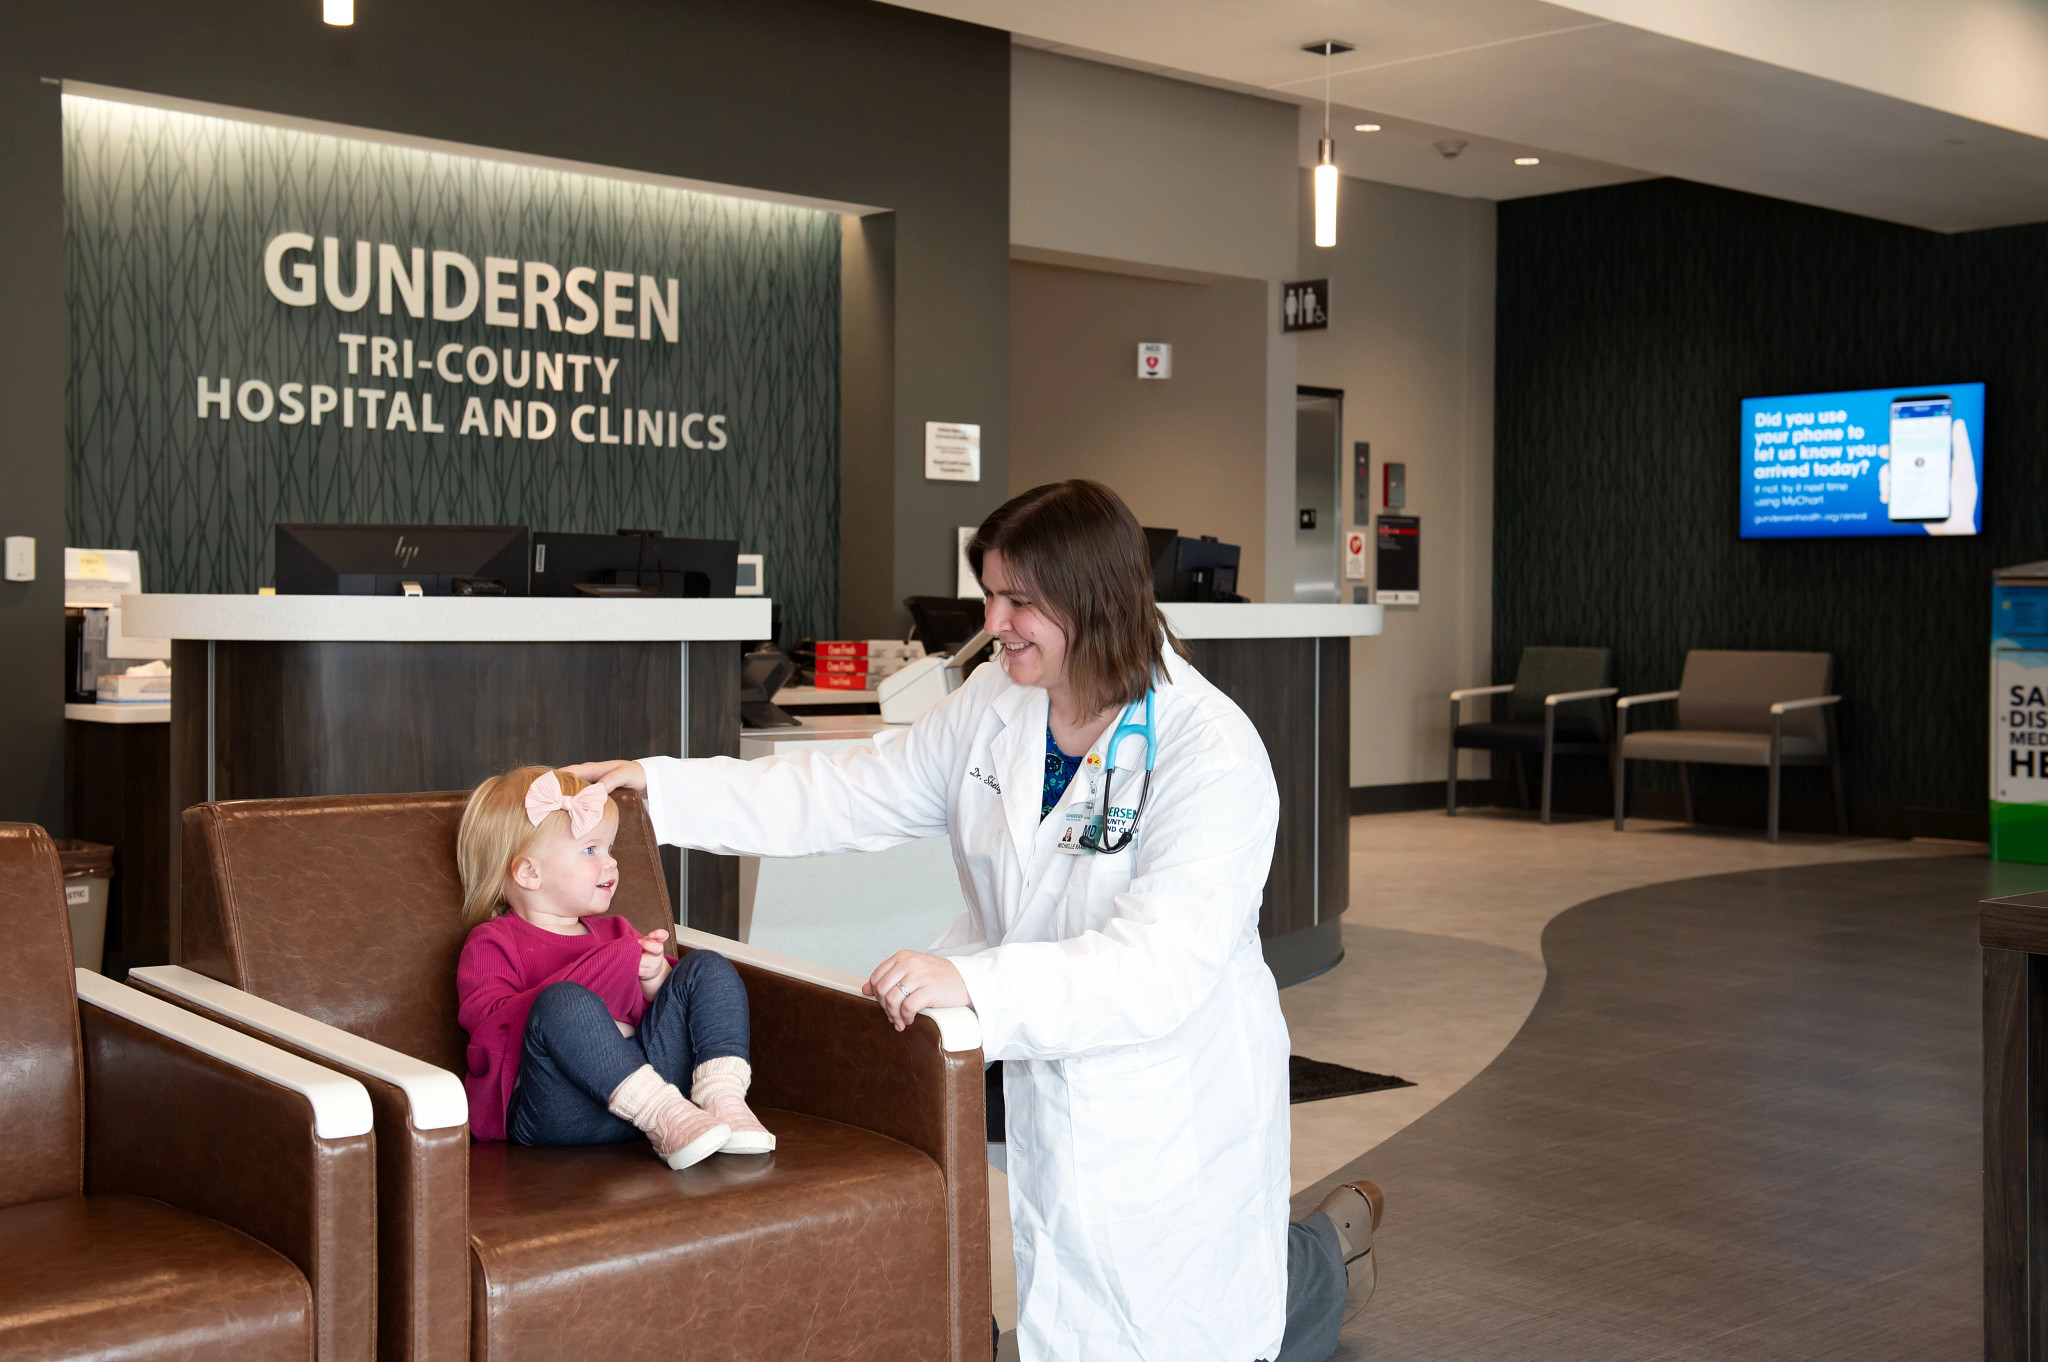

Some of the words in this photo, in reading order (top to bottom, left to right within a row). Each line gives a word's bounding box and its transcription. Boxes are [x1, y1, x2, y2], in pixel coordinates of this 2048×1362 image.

[264, 232, 679, 343] GUNDERSEN
[338, 333, 619, 395] TRI-COUNTY
[197, 376, 444, 433] HOSPITAL
[459, 397, 557, 440] AND
[570, 404, 728, 451] CLINICS
[1755, 411, 1782, 428] Did
[1785, 412, 1815, 429] you
[1818, 410, 1847, 424] use
[1755, 431, 1789, 447] your
[1792, 427, 1844, 446] phone
[1847, 424, 1865, 440] to
[1755, 446, 1775, 462] let
[1778, 447, 1796, 461] us
[1800, 444, 1843, 460] know
[1846, 444, 1876, 461] you
[1754, 462, 1810, 479] arrived
[1813, 459, 1870, 478] today?
[1781, 495, 1824, 507] MyChart
[2010, 685, 2048, 707] SA
[970, 767, 982, 780] Dr.
[1083, 825, 1097, 837] MD
